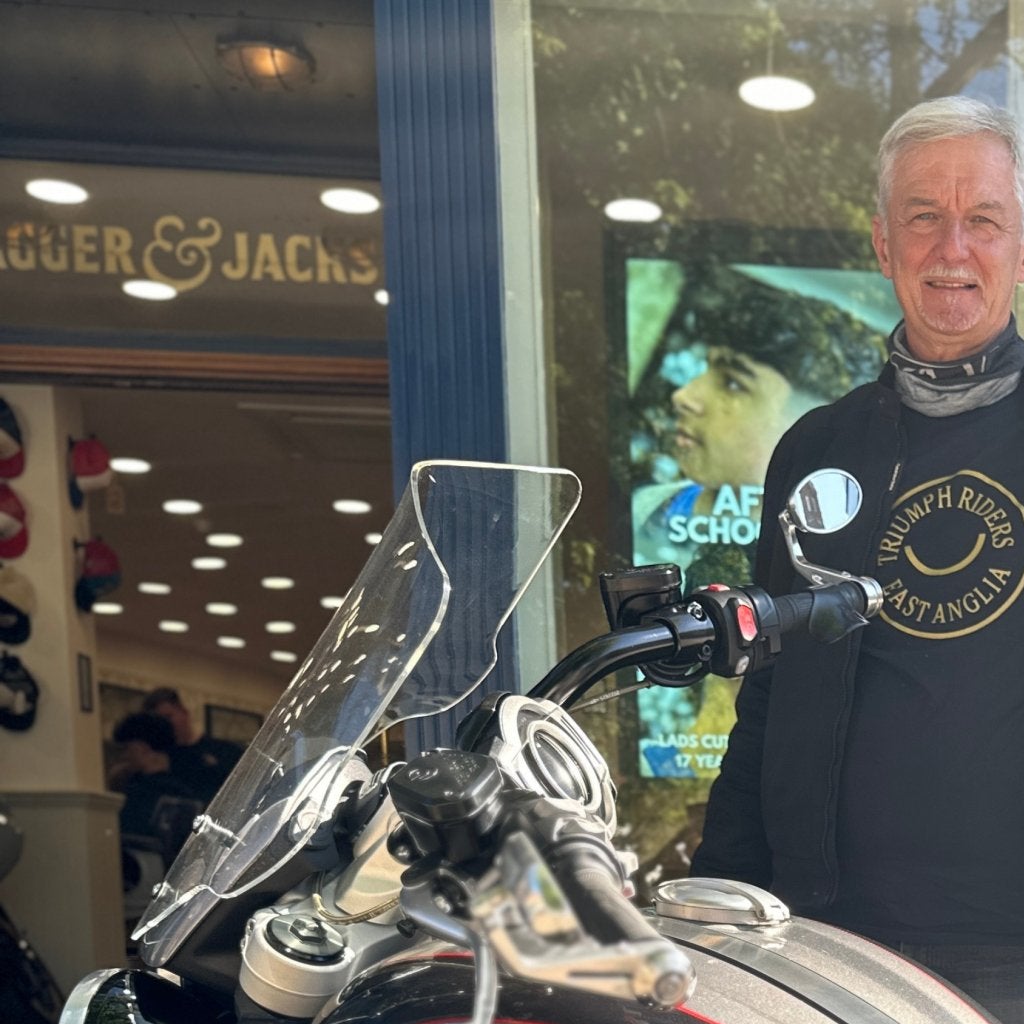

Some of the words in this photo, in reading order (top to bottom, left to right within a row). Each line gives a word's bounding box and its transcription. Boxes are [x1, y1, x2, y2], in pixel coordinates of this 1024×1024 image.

[0, 223, 136, 275] GGER
[877, 485, 953, 567] TRIUMPH
[957, 486, 1015, 550] RIDERS
[882, 578, 931, 623] EAST
[931, 567, 1012, 624] ANGLIA
[658, 733, 698, 748] LADS
[675, 754, 691, 768] 17
